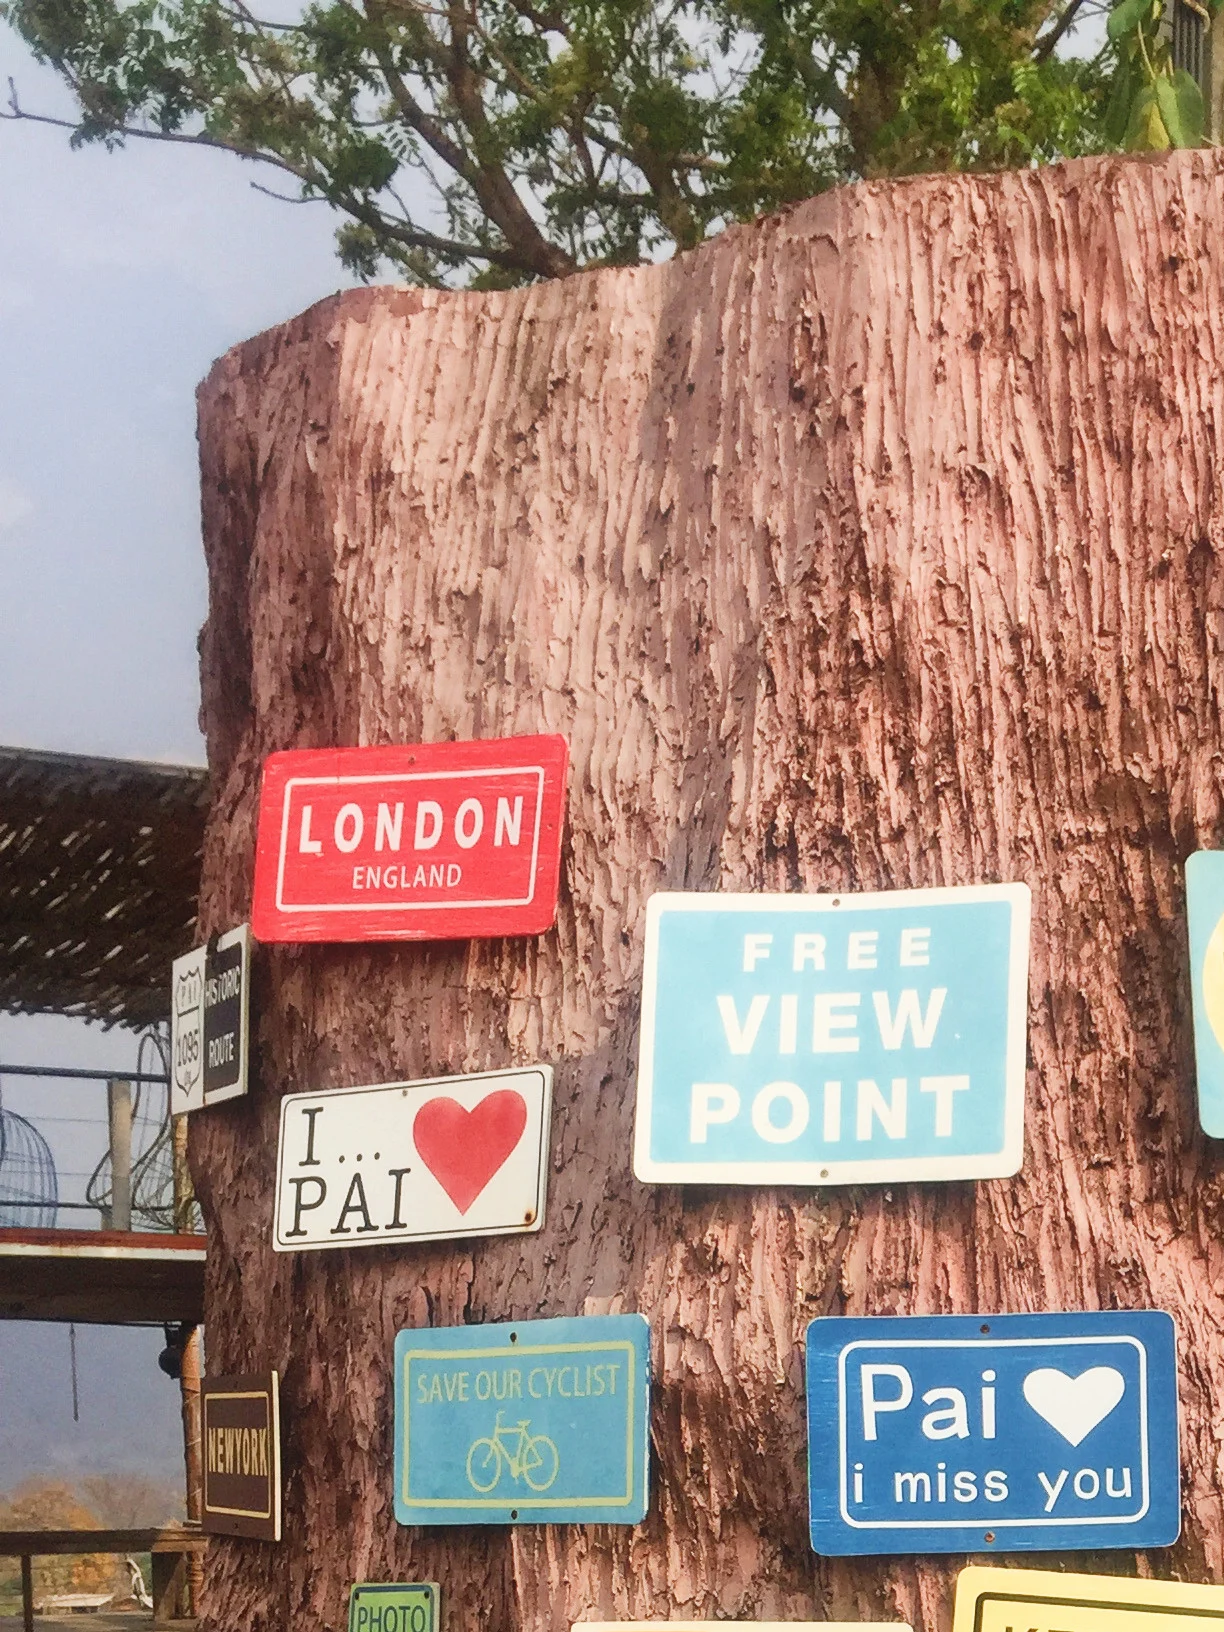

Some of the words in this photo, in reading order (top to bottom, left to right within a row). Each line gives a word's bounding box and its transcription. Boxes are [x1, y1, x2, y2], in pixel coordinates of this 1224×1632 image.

[299, 796, 524, 853] LONDON
[352, 863, 461, 890] ENGLAND
[742, 927, 931, 972] FREE
[205, 966, 240, 1008] HISTORIC
[717, 988, 947, 1054] VIEW
[177, 1028, 199, 1068] 1095
[208, 1031, 235, 1068] ROUTE
[690, 1075, 970, 1144] POINT
[286, 1168, 410, 1238] PAI
[417, 1370, 469, 1404] SAVE
[474, 1367, 522, 1400] OUR
[528, 1365, 621, 1399] CYCLIST
[860, 1363, 997, 1441] Pai
[207, 1426, 268, 1477] NEWYORK
[853, 1462, 864, 1504] i
[894, 1462, 1009, 1504] miss
[1037, 1467, 1132, 1513] you
